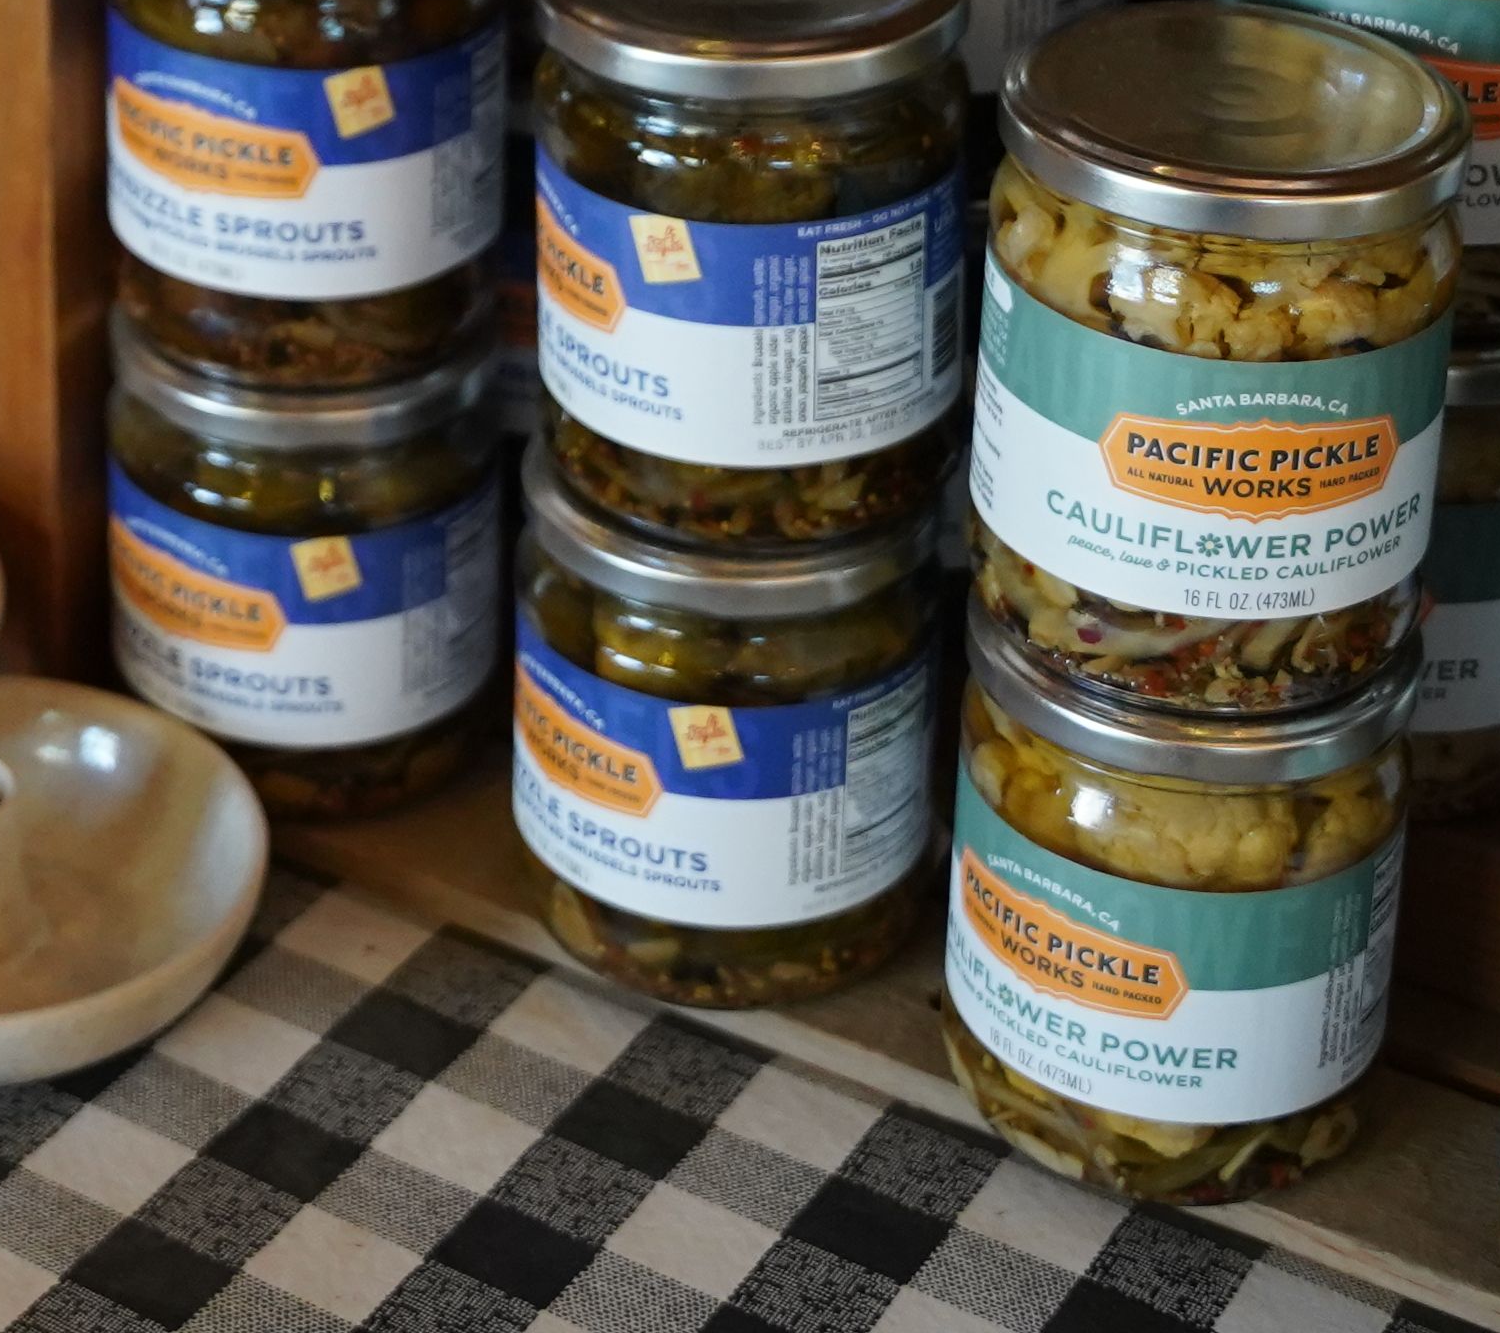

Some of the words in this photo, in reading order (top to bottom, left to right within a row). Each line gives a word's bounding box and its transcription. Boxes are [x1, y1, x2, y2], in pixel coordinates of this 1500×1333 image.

[1438, 35, 1461, 55] CA
[192, 133, 295, 166] PICKLE
[214, 211, 367, 244] SPROUTS
[556, 325, 669, 398] SPROUTS
[1176, 395, 1237, 416] SANTA
[1327, 399, 1348, 415] CA
[1126, 432, 1261, 473] PACIFIC
[1268, 433, 1381, 473] PICKLE
[1126, 466, 1146, 479] ALL
[1148, 472, 1195, 488] NATURAL
[1202, 475, 1312, 499] WORKS
[1319, 475, 1345, 489] HAND
[1347, 466, 1381, 484] PACKED
[1324, 492, 1421, 553] POWER
[1066, 533, 1116, 563] peace,
[1119, 554, 1153, 572] love
[1156, 558, 1171, 572] &
[1175, 561, 1268, 582] PICKLED
[1276, 536, 1402, 579] CAULIFLOWER
[1183, 588, 1199, 607] 16
[1203, 590, 1223, 609] FL
[1228, 591, 1253, 610] OZ.
[1255, 587, 1316, 612] (473ML)
[188, 657, 332, 696] SPROUTS
[552, 732, 638, 784] PICKLE
[568, 810, 710, 873] SPROUTS
[987, 853, 1023, 878] SANTA
[1098, 908, 1121, 933] CA
[965, 867, 1039, 946] PACIFIC
[1047, 930, 1161, 987] PICKLE
[1000, 932, 1085, 988] WORKS
[984, 997, 1048, 1050] PICKLED
[1055, 1044, 1203, 1089] CAULIFLOWER
[1100, 1031, 1238, 1072] POWER
